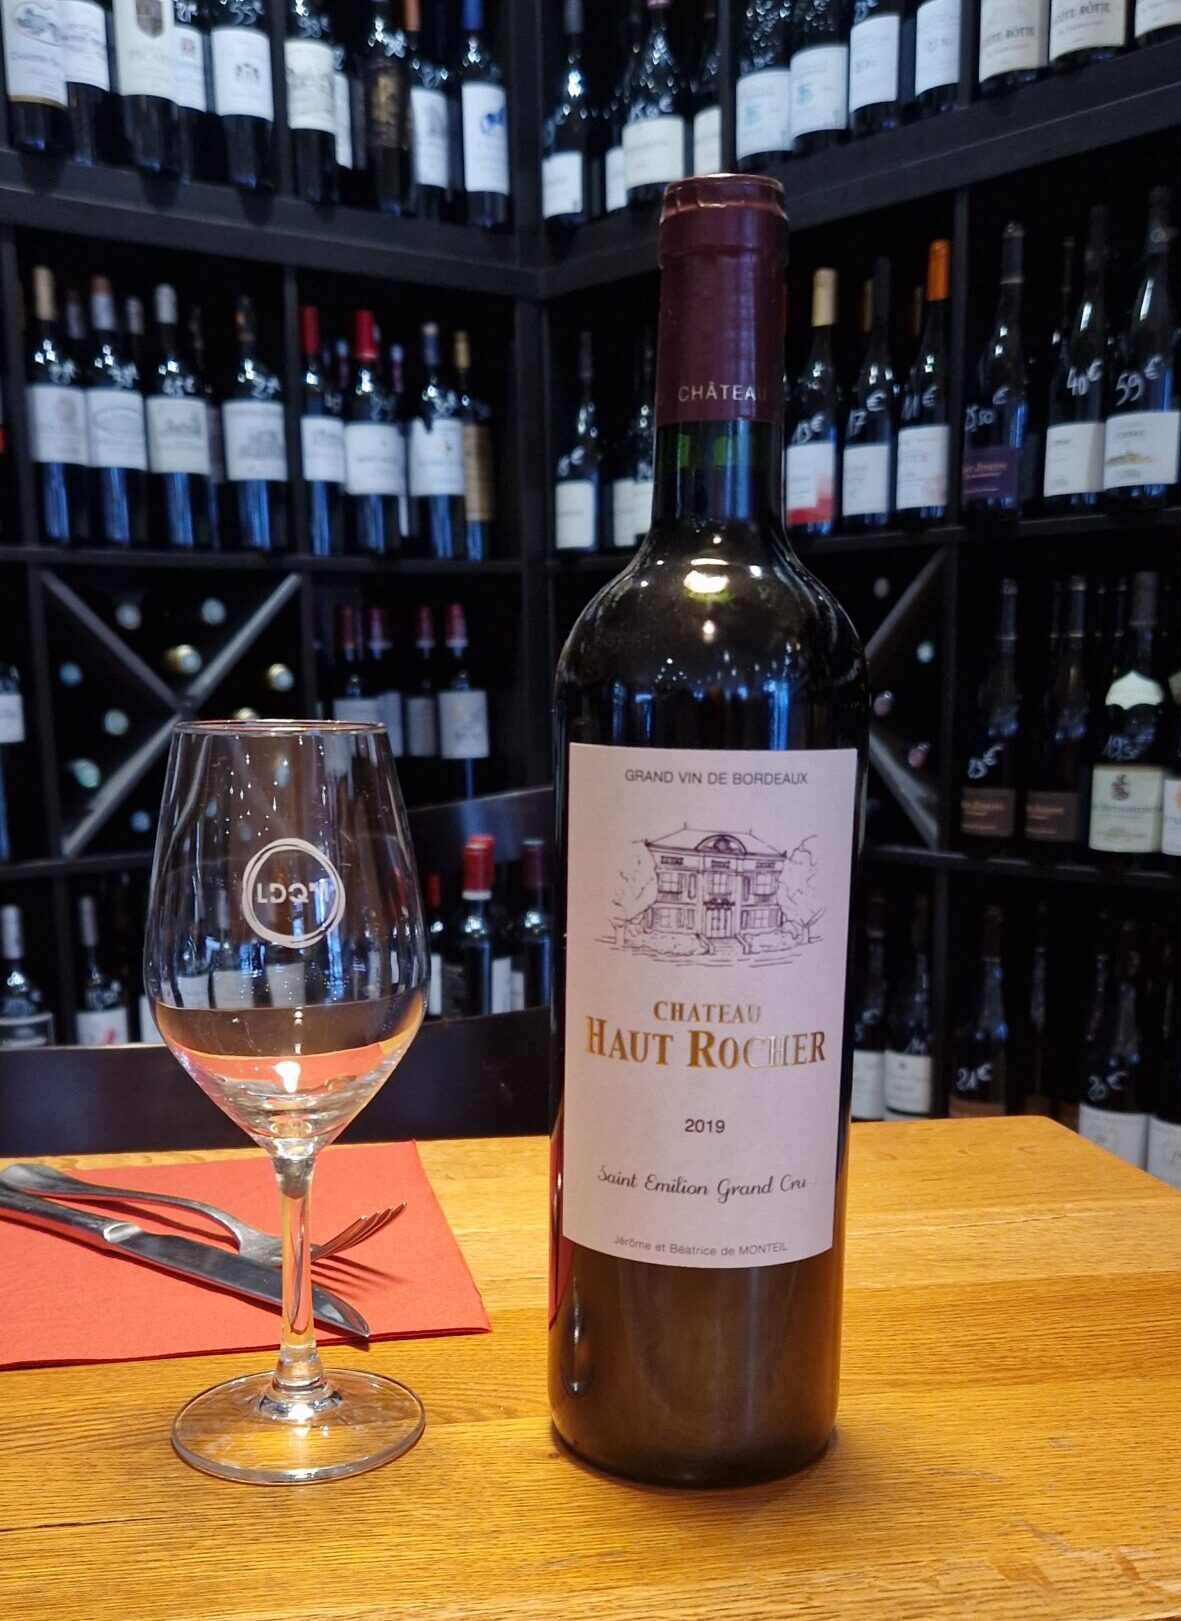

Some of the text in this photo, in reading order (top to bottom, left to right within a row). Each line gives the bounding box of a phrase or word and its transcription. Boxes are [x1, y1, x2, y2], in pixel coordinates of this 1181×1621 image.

[624, 769, 809, 787] GRAND VIN DE BORDEAUX
[653, 1000, 762, 1025] CHATEAU
[684, 1119, 727, 1134] 2019
[598, 1165, 808, 1204] Saint Emilion Grand Cru
[613, 1235, 788, 1257] Jérôme et Béatrice de MONTEIL
